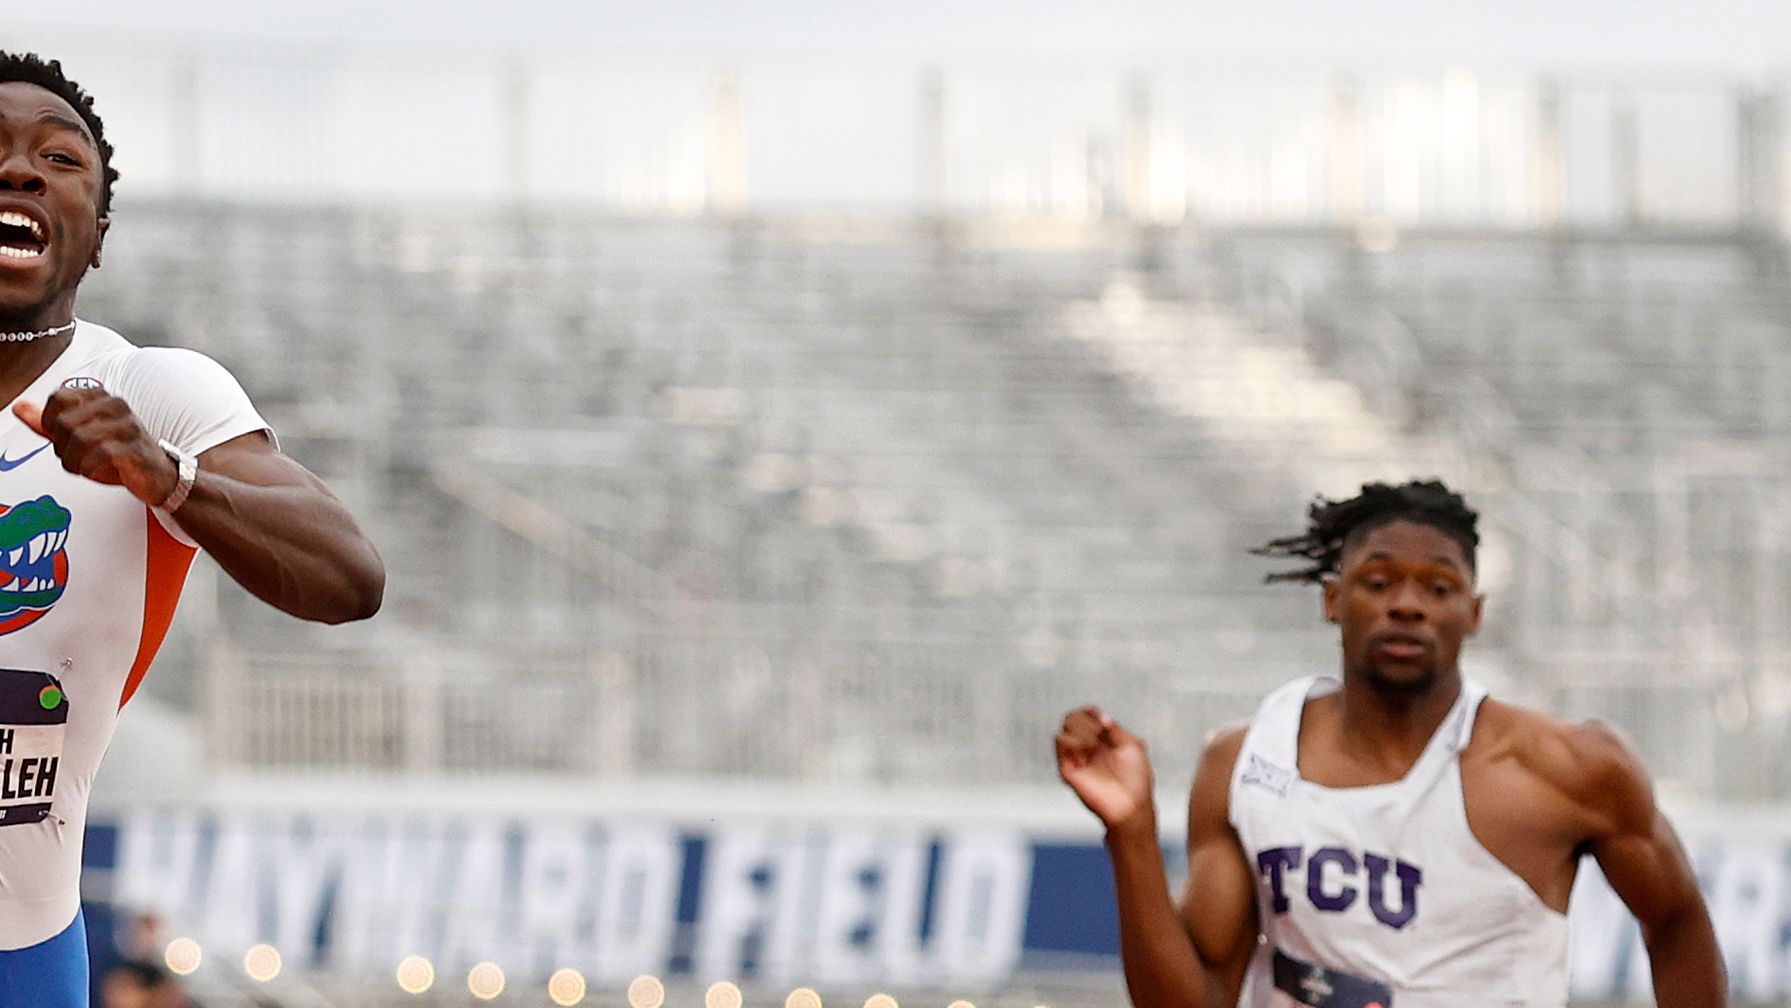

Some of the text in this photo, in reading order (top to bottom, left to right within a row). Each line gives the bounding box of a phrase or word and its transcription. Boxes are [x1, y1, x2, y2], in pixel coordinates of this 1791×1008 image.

[113, 815, 1035, 988] HAYWARD FIELD
[1257, 846, 1422, 930] TCU
